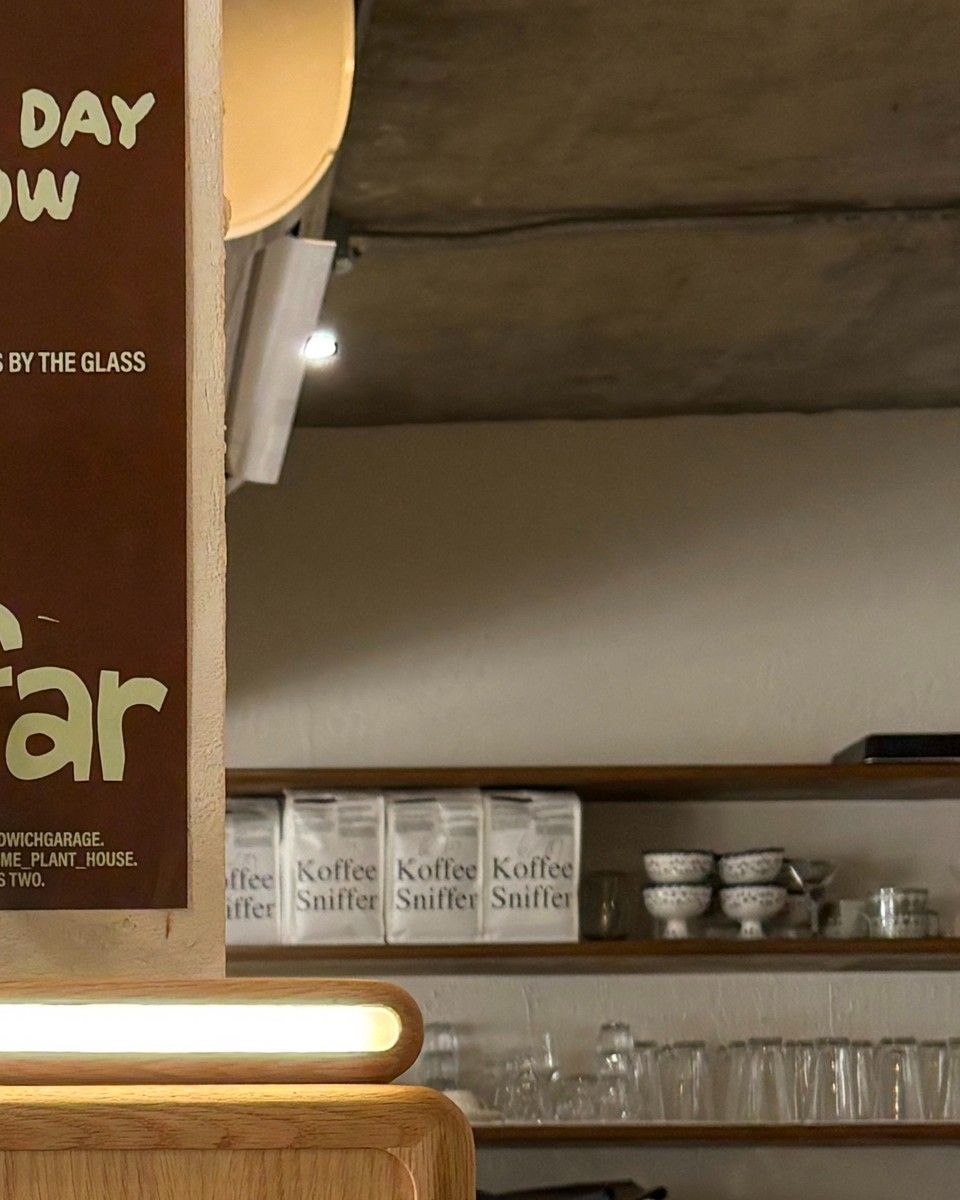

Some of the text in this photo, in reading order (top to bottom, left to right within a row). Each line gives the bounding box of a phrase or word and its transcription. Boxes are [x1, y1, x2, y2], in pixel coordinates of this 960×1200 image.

[20, 88, 155, 149] DAY
[9, 352, 34, 373] BY
[39, 352, 76, 373] THE
[80, 351, 146, 373] GLASS
[9, 871, 45, 888] TWO.
[225, 868, 274, 890] ffee
[297, 858, 377, 882] Koffee
[397, 857, 477, 881] Koffee
[493, 855, 572, 880] Koffee
[297, 887, 378, 911] Sniffer
[396, 887, 477, 910] Sniffer
[492, 885, 570, 909] Sniffer
